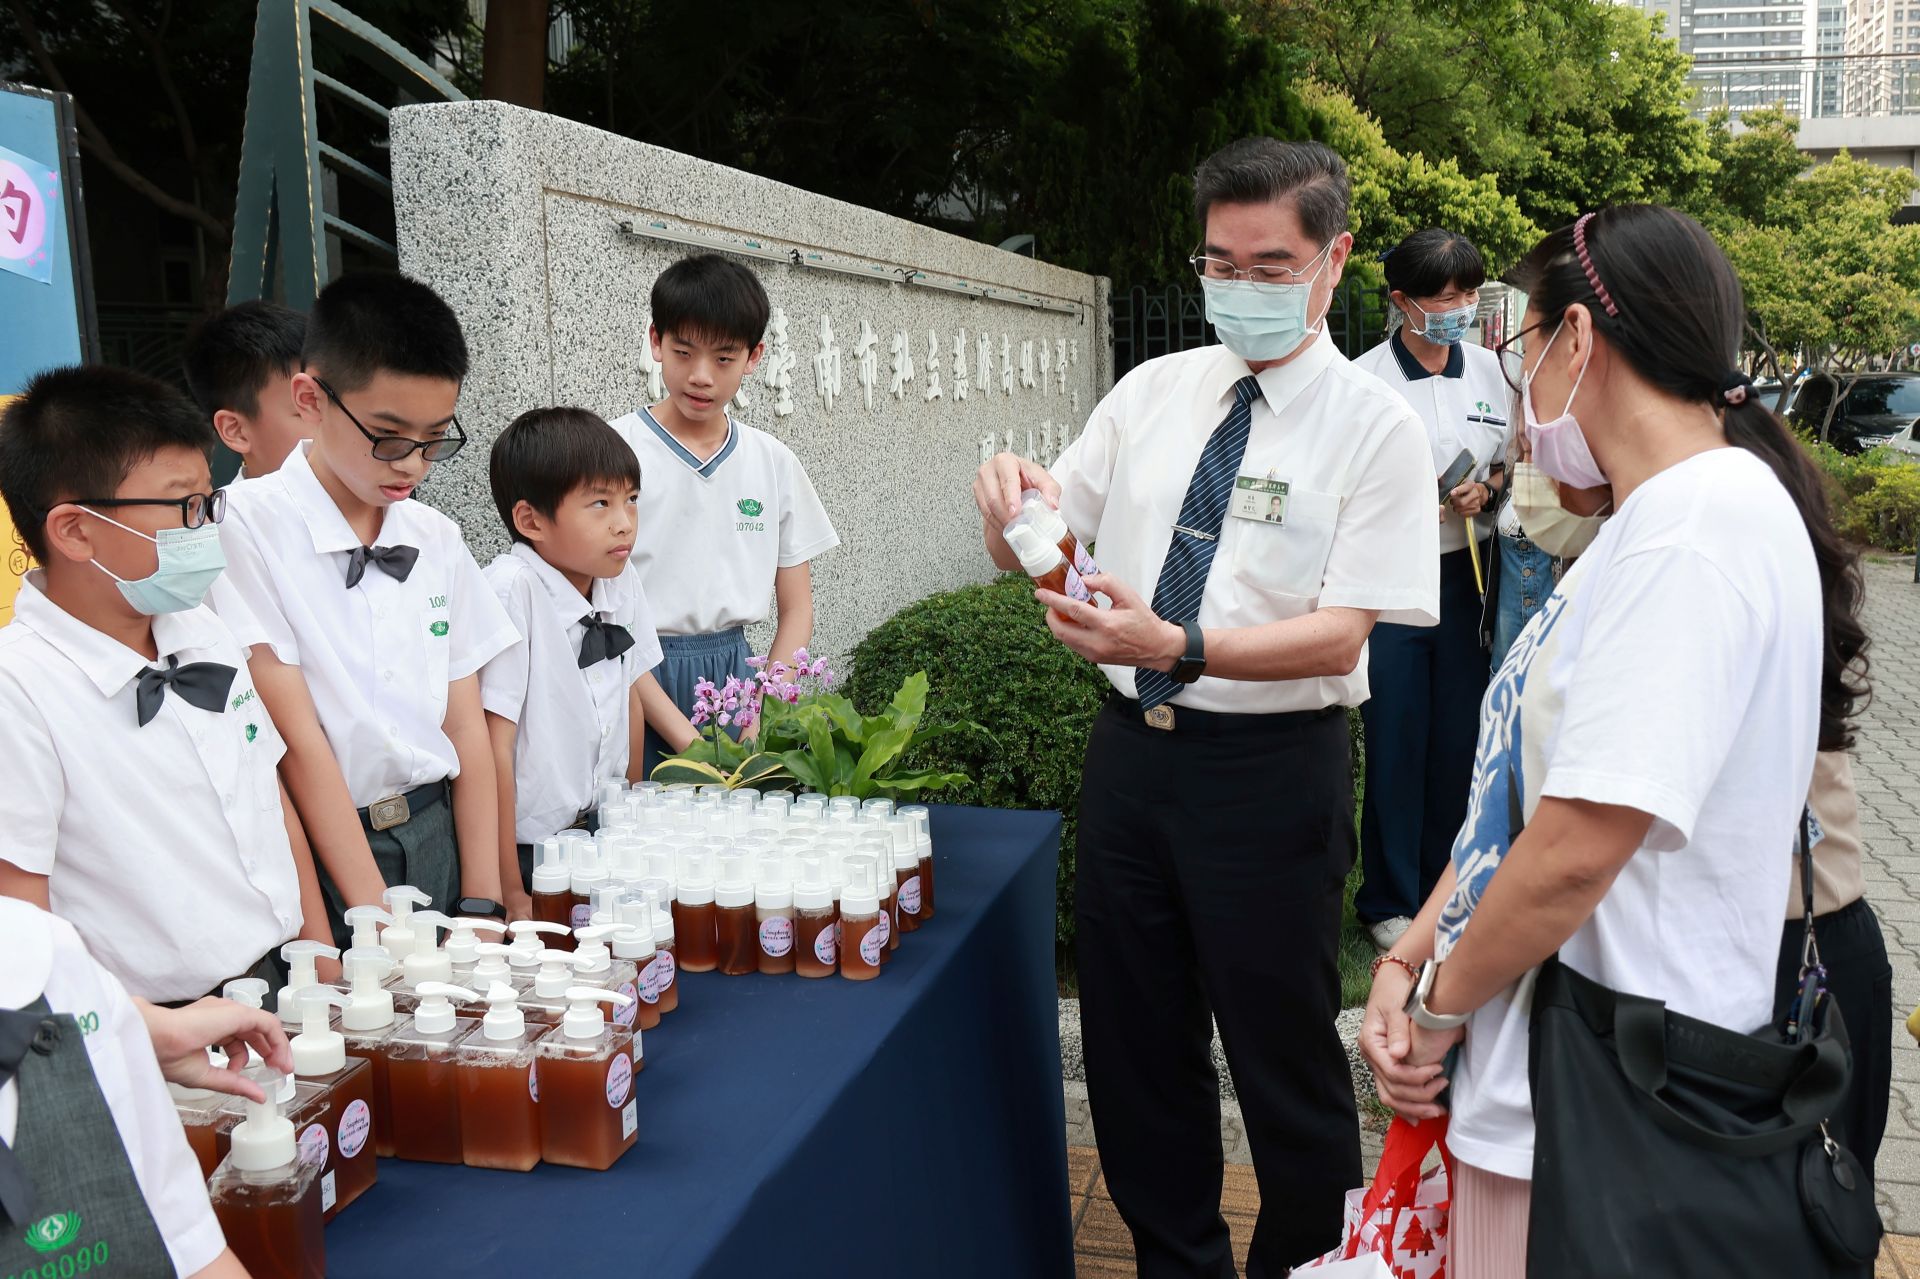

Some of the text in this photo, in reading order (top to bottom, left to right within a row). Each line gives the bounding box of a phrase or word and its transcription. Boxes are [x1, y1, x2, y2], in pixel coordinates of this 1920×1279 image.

[735, 522, 764, 532] 107042
[428, 594, 447, 608] 108
[7, 1240, 109, 1279] 9090
